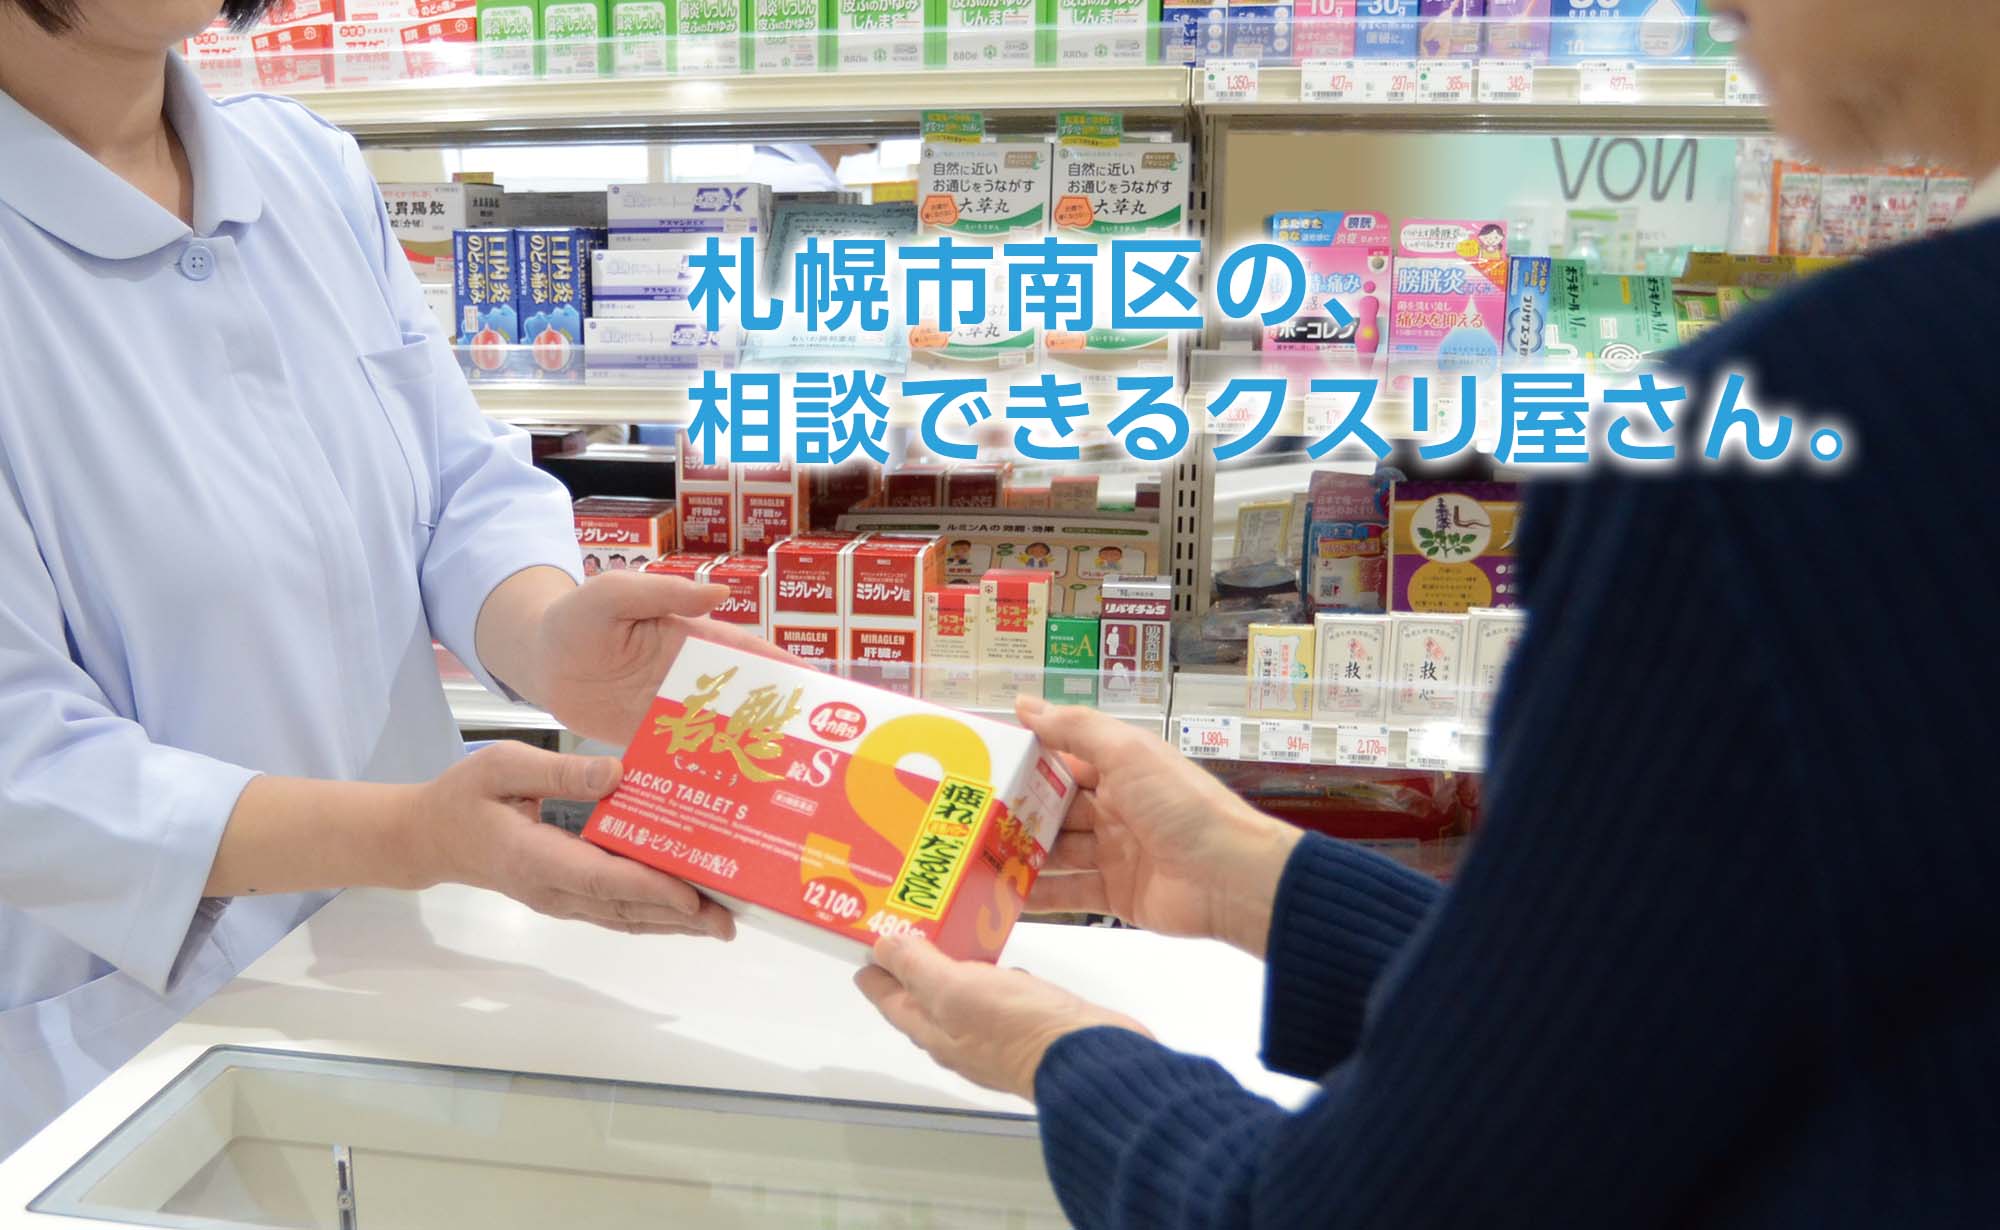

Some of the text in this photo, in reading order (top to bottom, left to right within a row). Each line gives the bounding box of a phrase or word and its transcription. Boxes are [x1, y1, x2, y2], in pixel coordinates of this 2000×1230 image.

[933, 162, 998, 176] 自然に近い
[1068, 163, 1135, 177] 自然に近い
[933, 180, 1035, 193] お通じをうながす
[1067, 181, 1172, 194] お通じをうながす
[959, 197, 1010, 214] 大草丸
[1094, 198, 1147, 215] 大草丸
[1398, 269, 1465, 295] 膀胱炎
[784, 631, 828, 642] MIRAGLEN
[860, 634, 905, 645] MIRAGLEN
[623, 767, 750, 821] JACKO TABLET S
